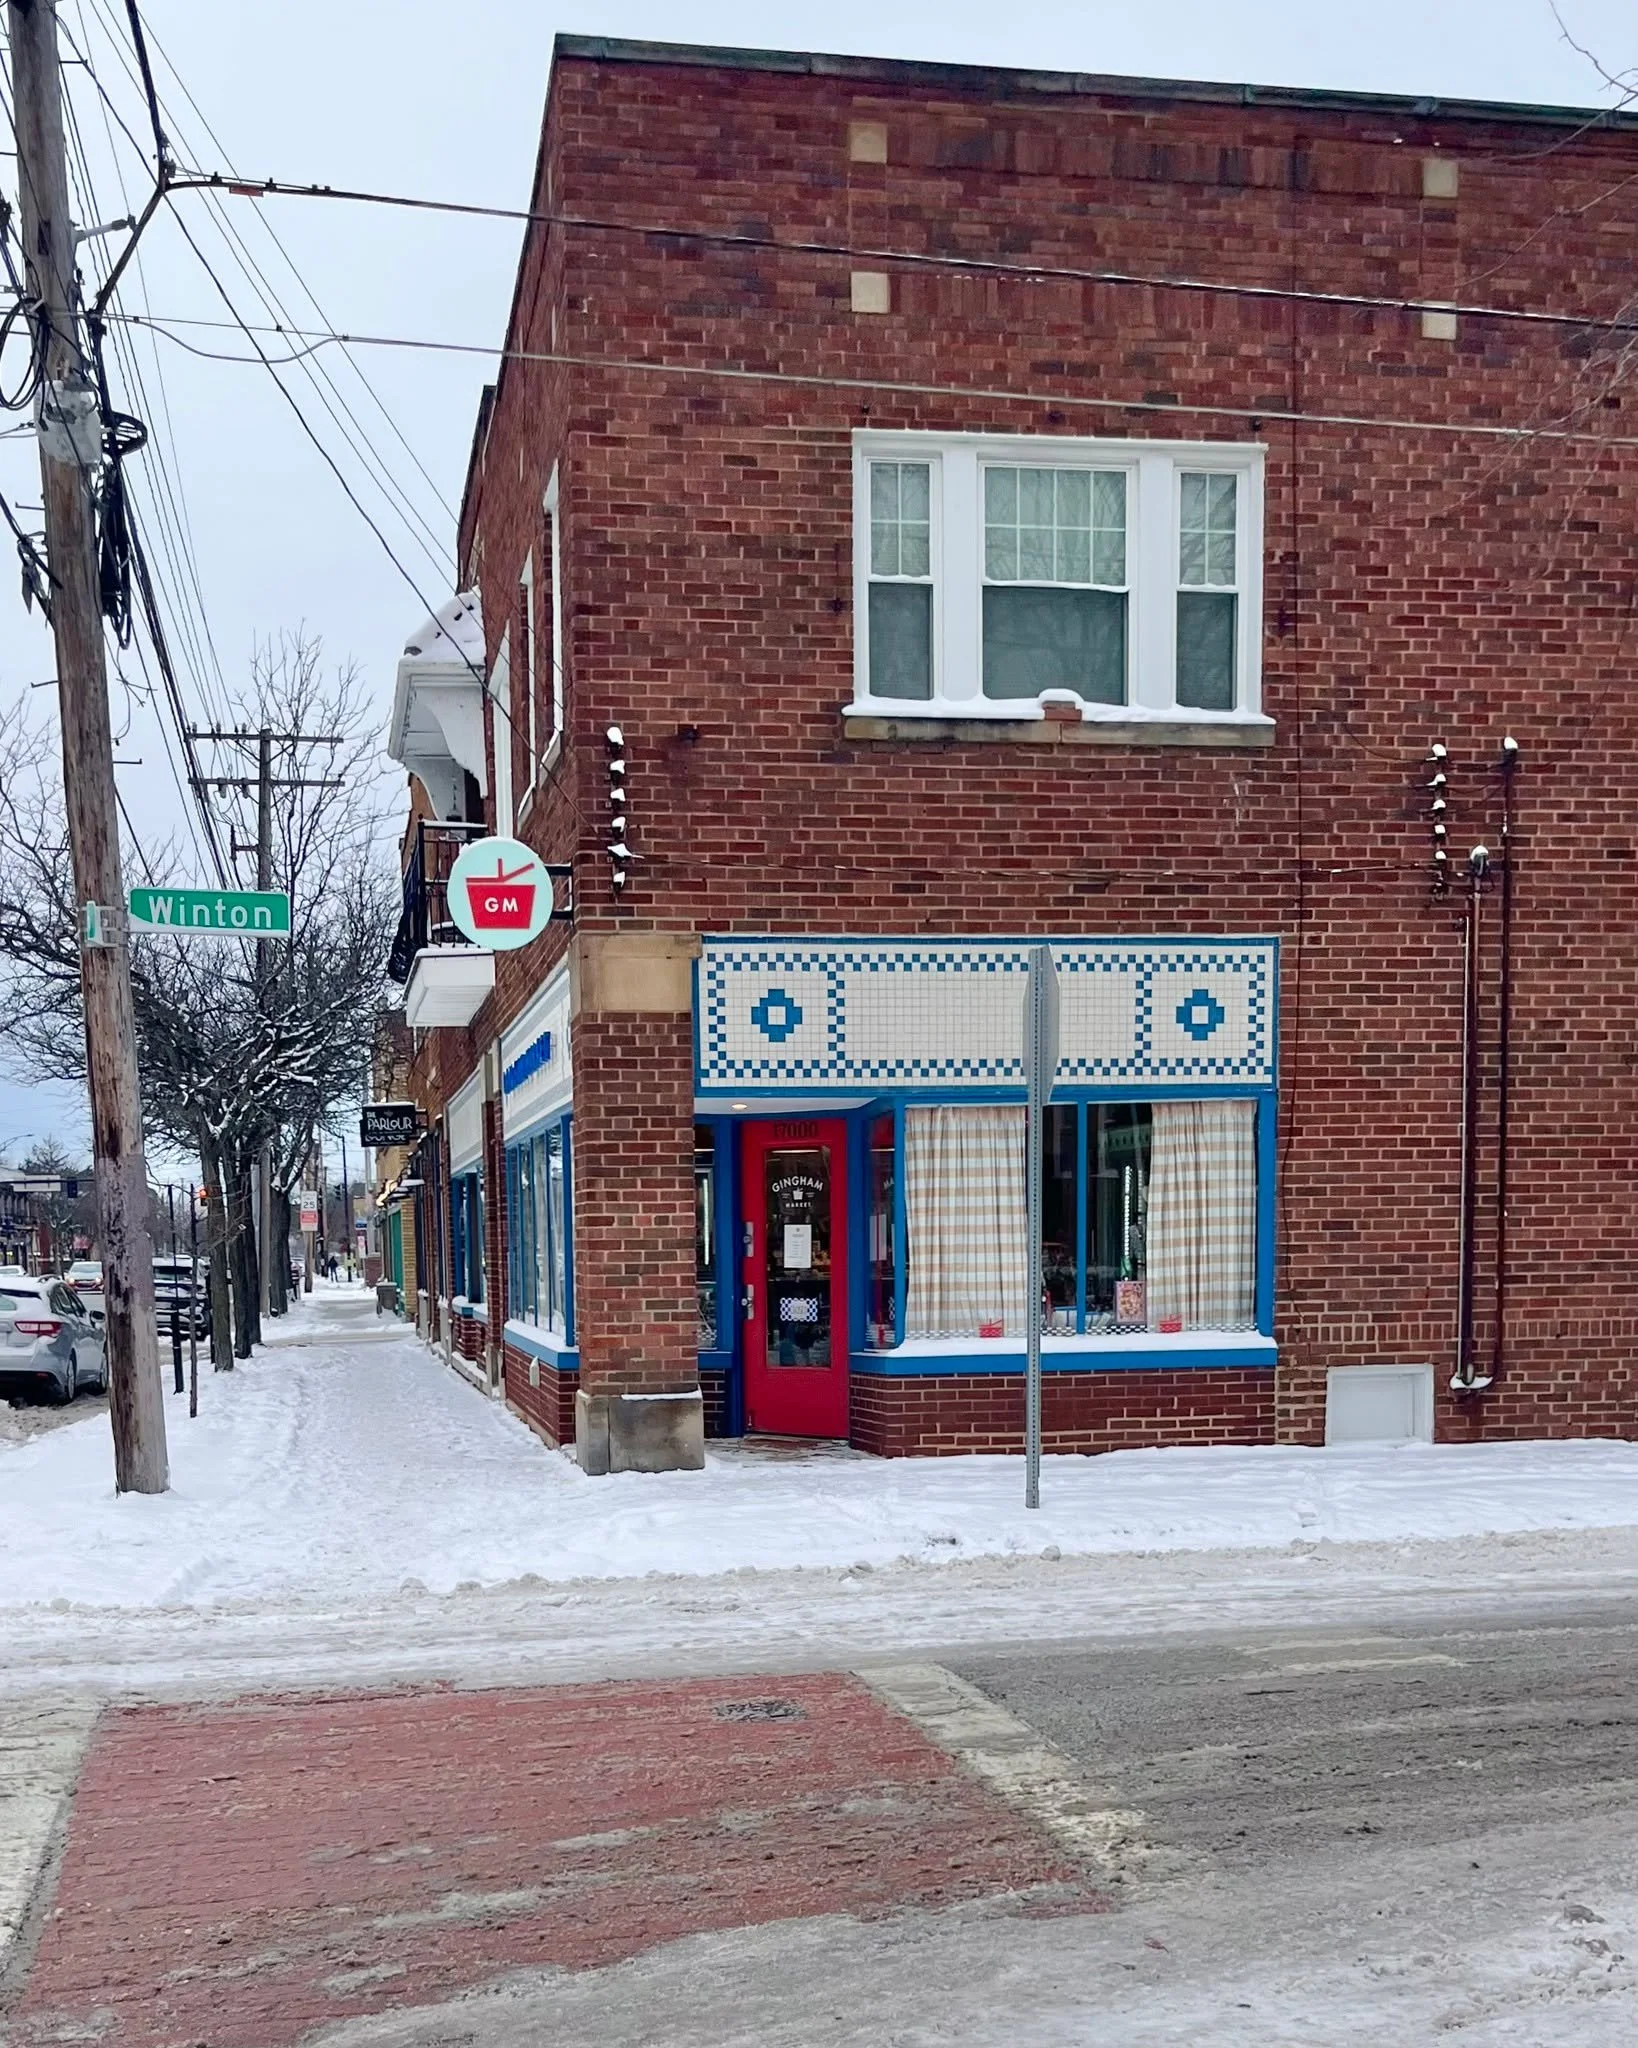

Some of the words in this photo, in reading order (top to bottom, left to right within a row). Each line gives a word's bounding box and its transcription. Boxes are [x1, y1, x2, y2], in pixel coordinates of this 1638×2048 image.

[148, 896, 272, 928] Winton
[484, 897, 519, 913] GM
[367, 1116, 413, 1130] PARLOUR
[771, 1175, 824, 1193] GINGHAM
[303, 1201, 316, 1209] 25
